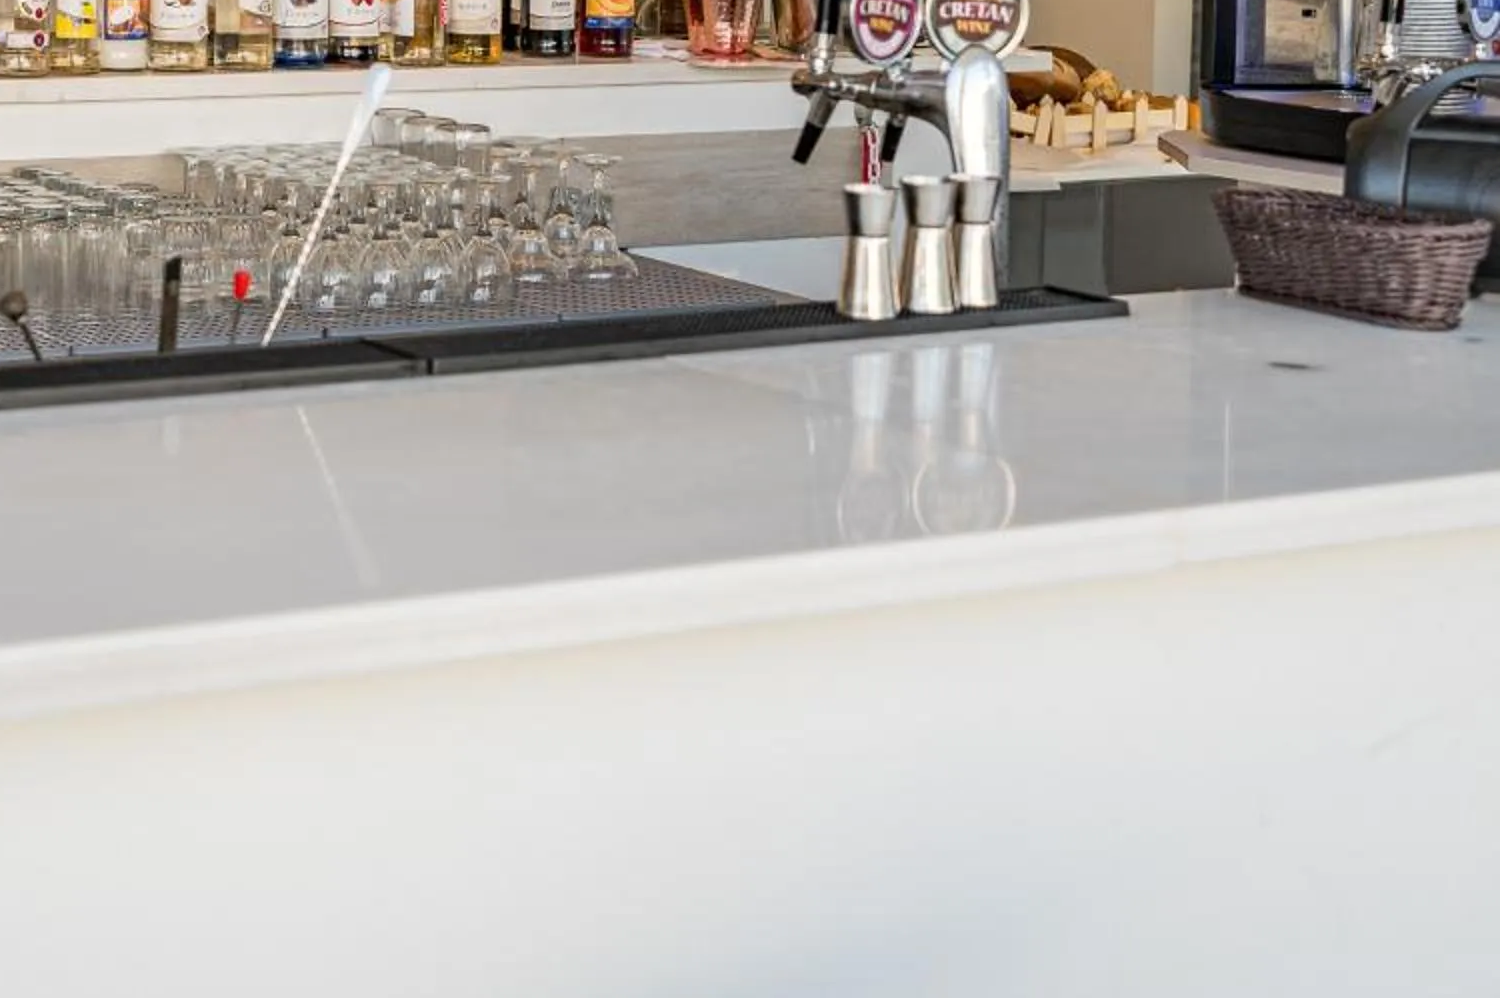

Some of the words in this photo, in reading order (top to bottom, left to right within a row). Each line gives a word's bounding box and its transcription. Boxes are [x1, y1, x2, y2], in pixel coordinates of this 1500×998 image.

[860, 0, 909, 23] CRETAN
[939, 1, 1015, 23] CRETAN
[955, 18, 993, 34] WINE
